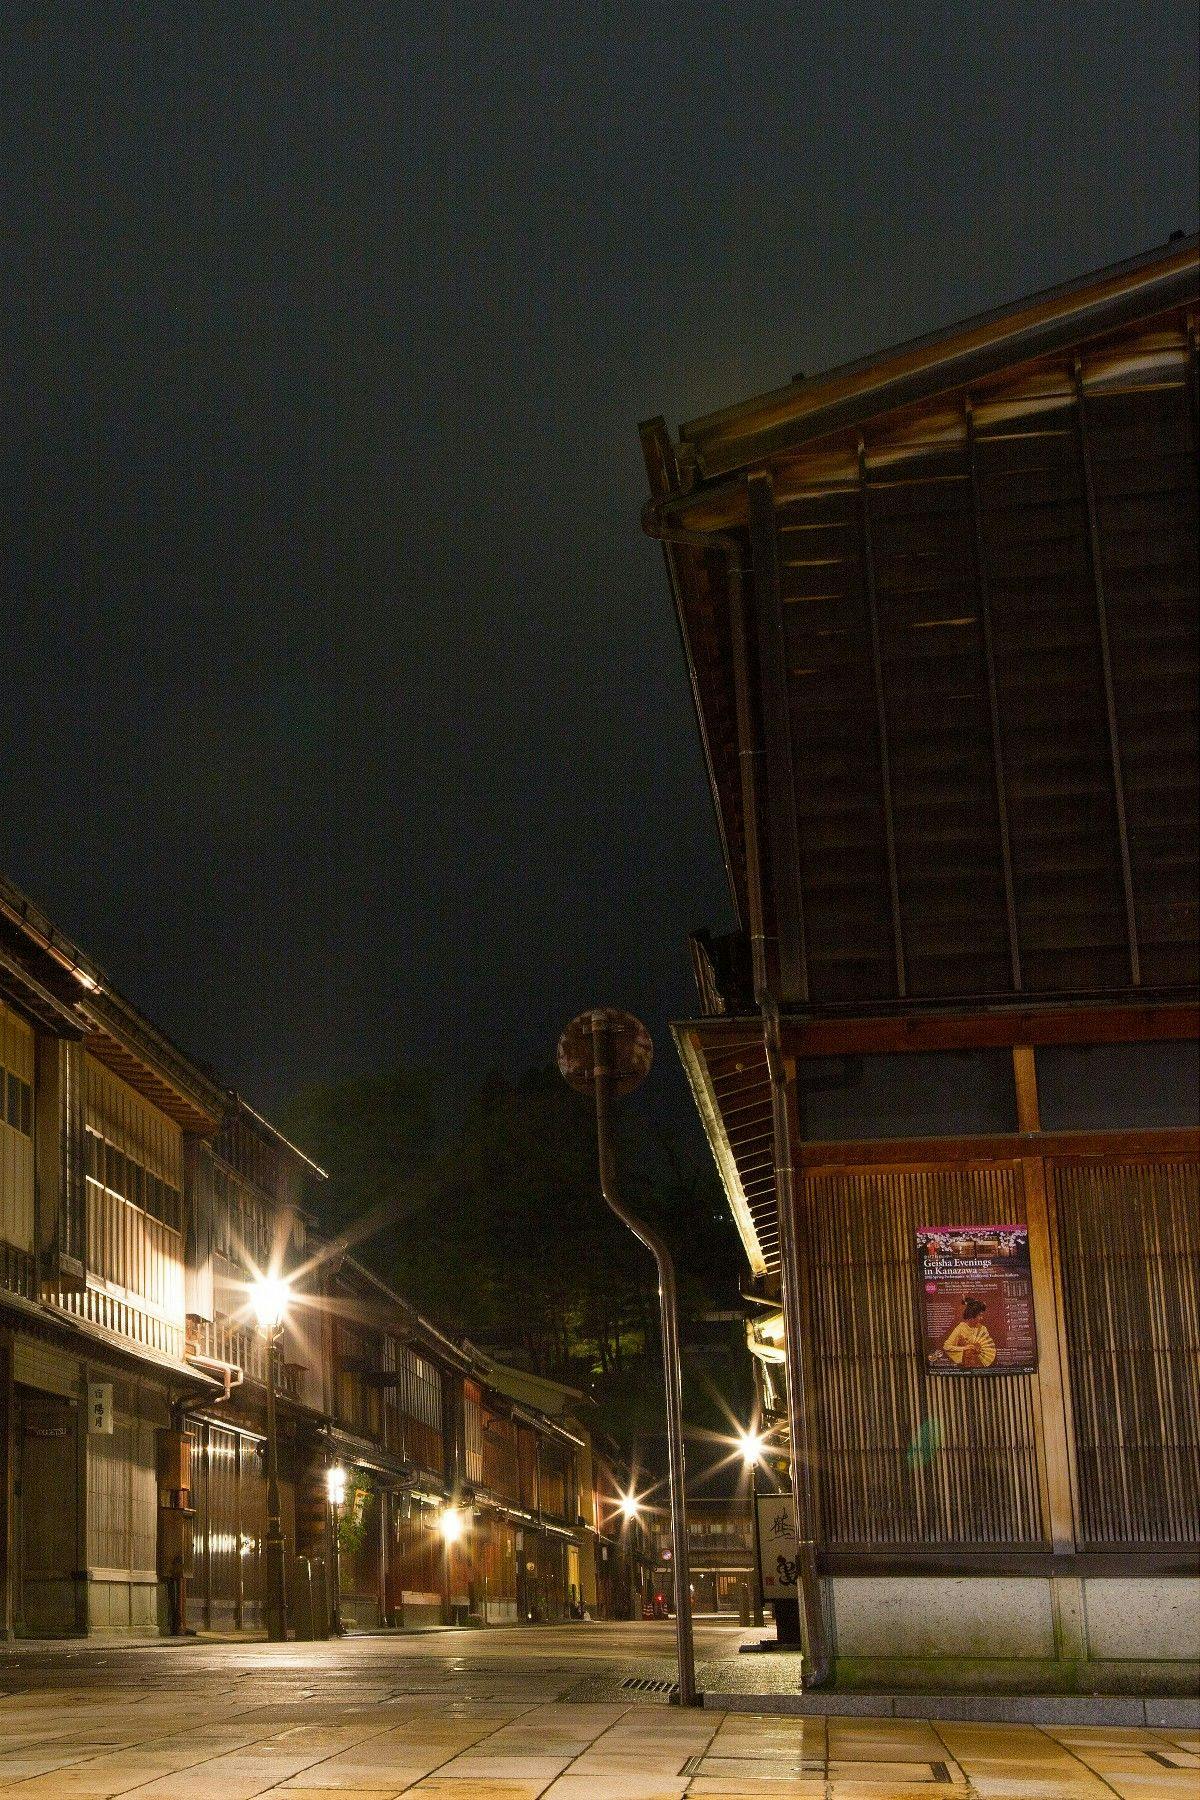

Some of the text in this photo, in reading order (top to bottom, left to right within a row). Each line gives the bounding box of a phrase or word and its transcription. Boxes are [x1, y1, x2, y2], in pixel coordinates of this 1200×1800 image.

[923, 1258, 992, 1268] Geisha Evenings
[924, 1267, 933, 1275] in
[935, 1266, 977, 1275] Kanazawa
